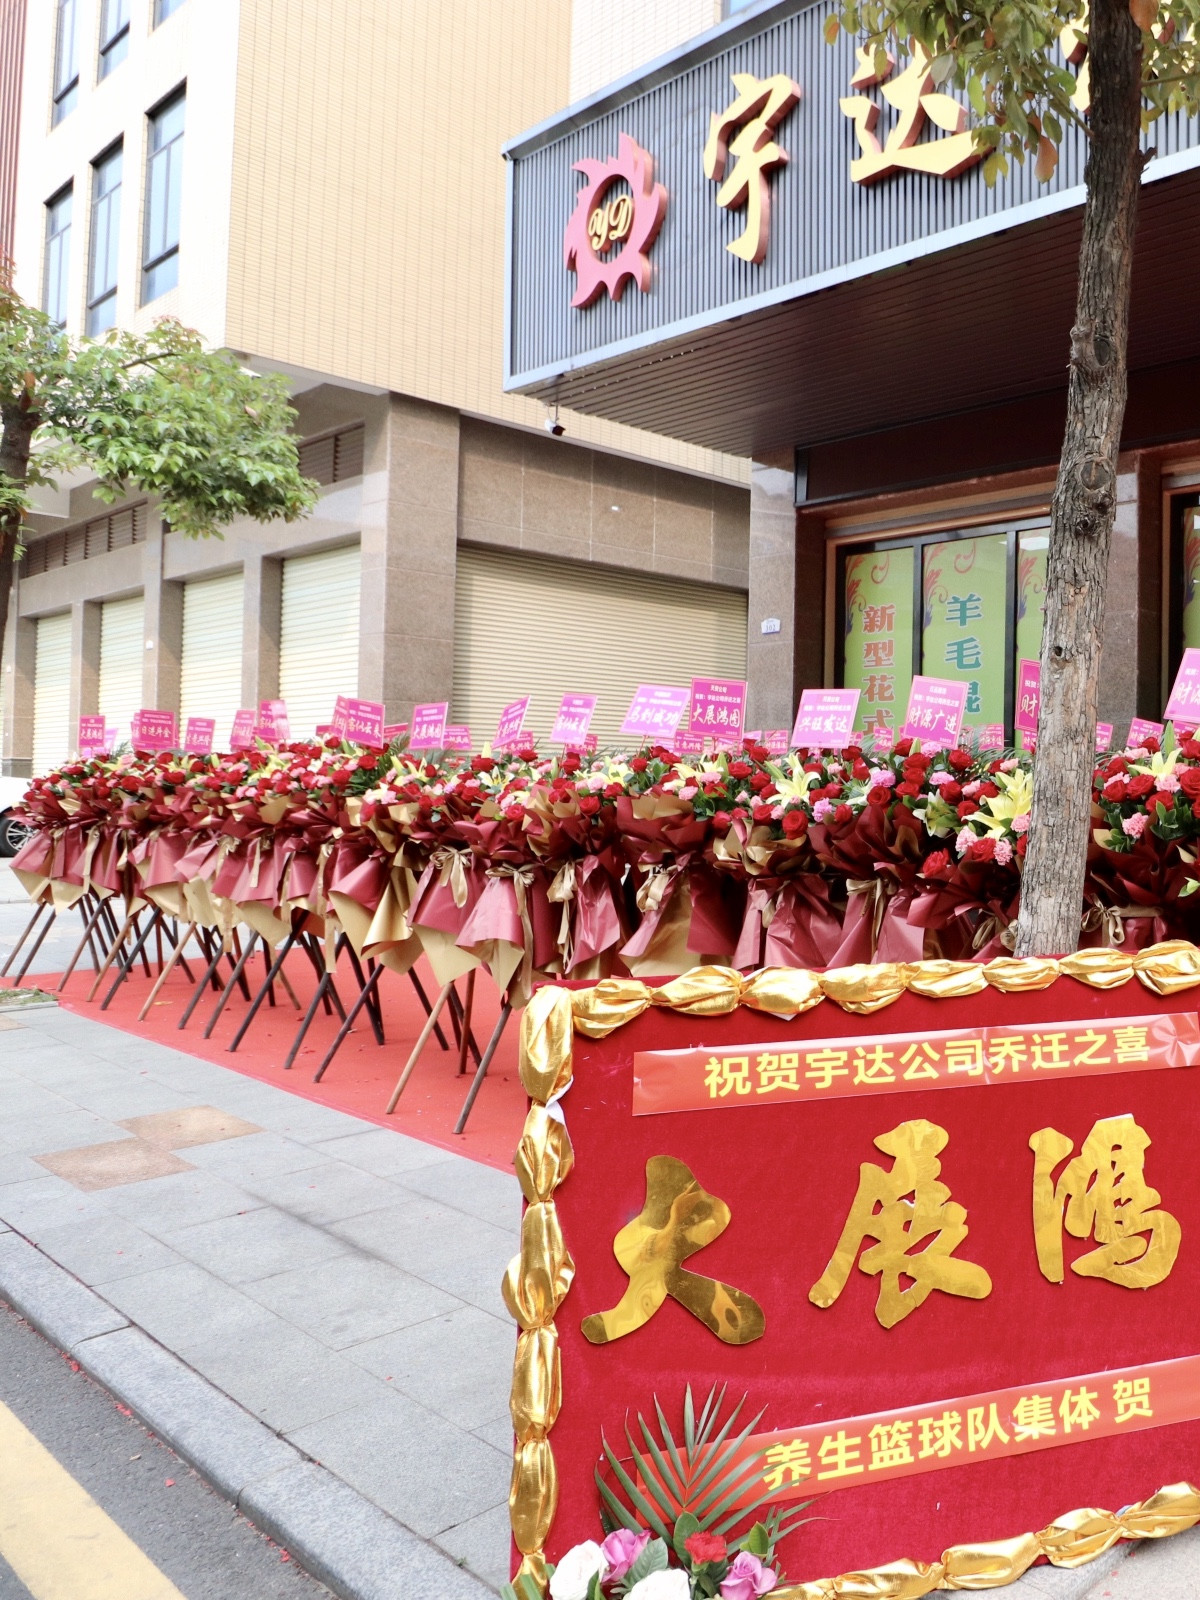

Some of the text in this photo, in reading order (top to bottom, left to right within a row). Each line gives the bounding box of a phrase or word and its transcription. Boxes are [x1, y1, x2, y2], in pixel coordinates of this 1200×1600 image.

[628, 707, 679, 727] 马到成功
[692, 703, 740, 728] 大展鸿图
[800, 713, 848, 734] 兴旺发达
[909, 706, 957, 734] 财源广进
[141, 727, 171, 738] 日进斗金
[348, 717, 381, 738] 客似云来
[704, 1026, 1150, 1098] 祝贺宇达公司乔迁之喜
